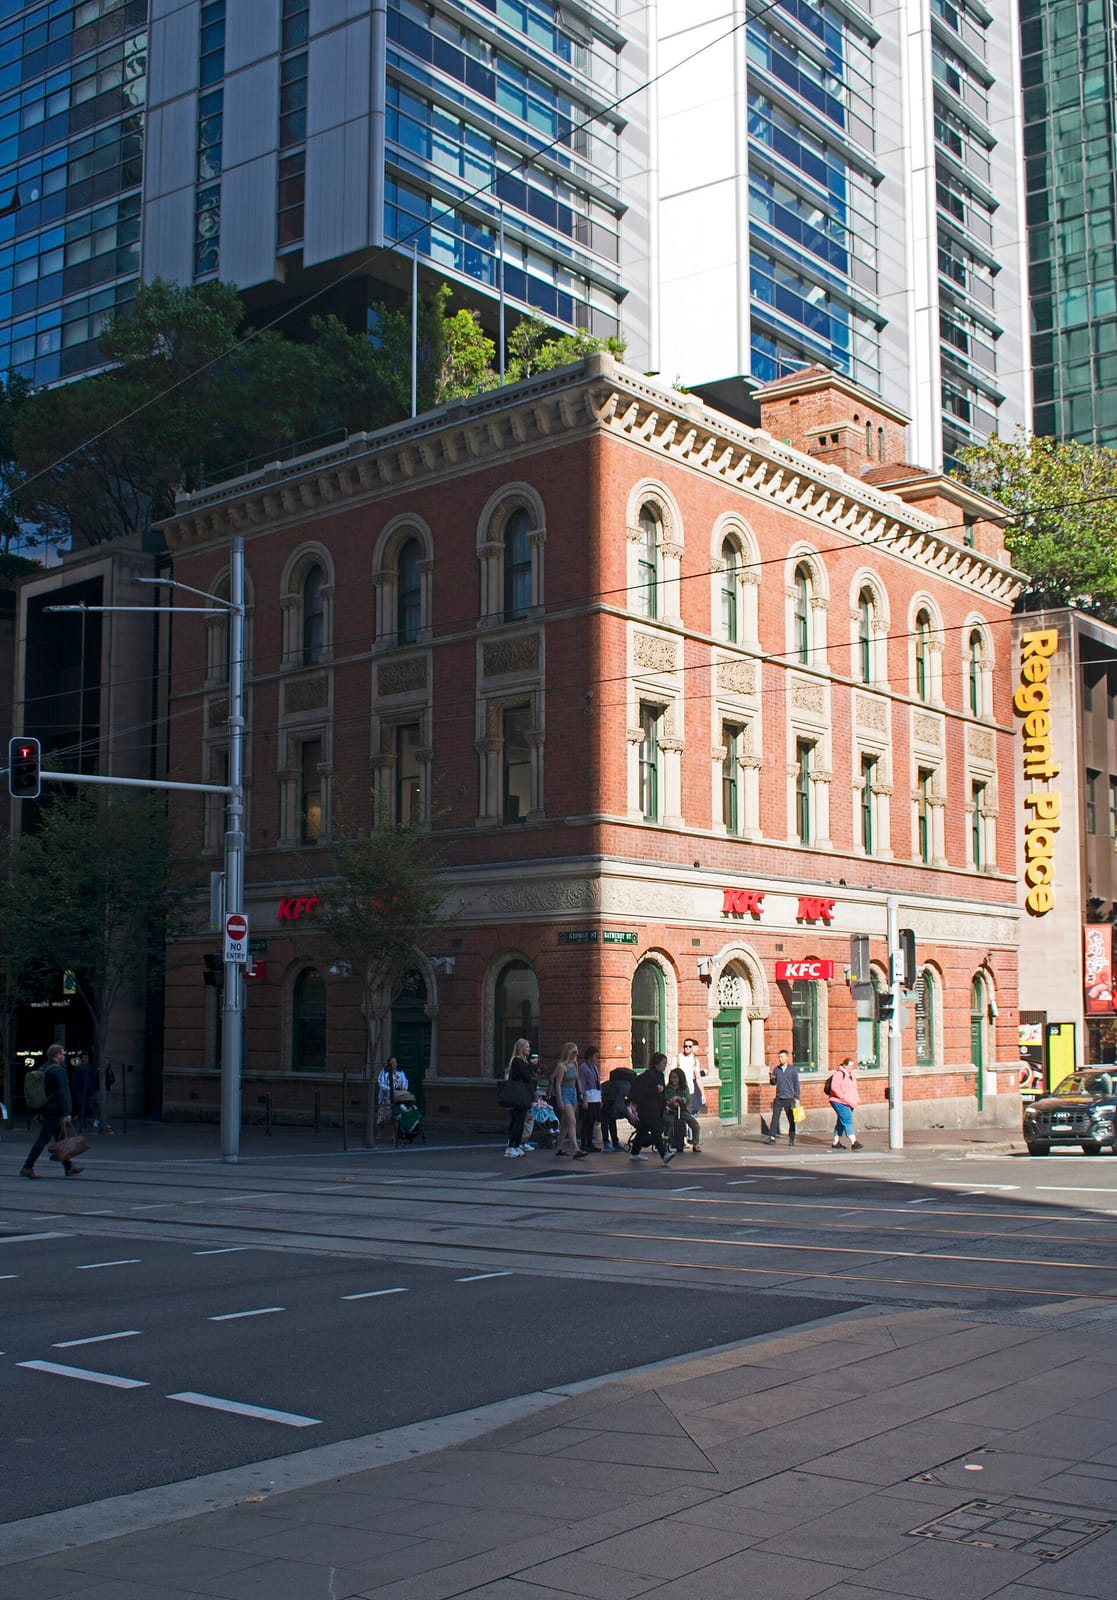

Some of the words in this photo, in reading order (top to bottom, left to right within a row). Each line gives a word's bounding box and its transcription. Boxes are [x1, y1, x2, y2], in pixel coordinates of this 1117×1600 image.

[1014, 629, 1060, 778] Regent
[1026, 791, 1061, 912] Place
[722, 890, 765, 914] KFC
[797, 897, 835, 920] KFC
[226, 952, 245, 960] ENTRY
[230, 942, 242, 951] NO
[785, 963, 821, 977] KFC
